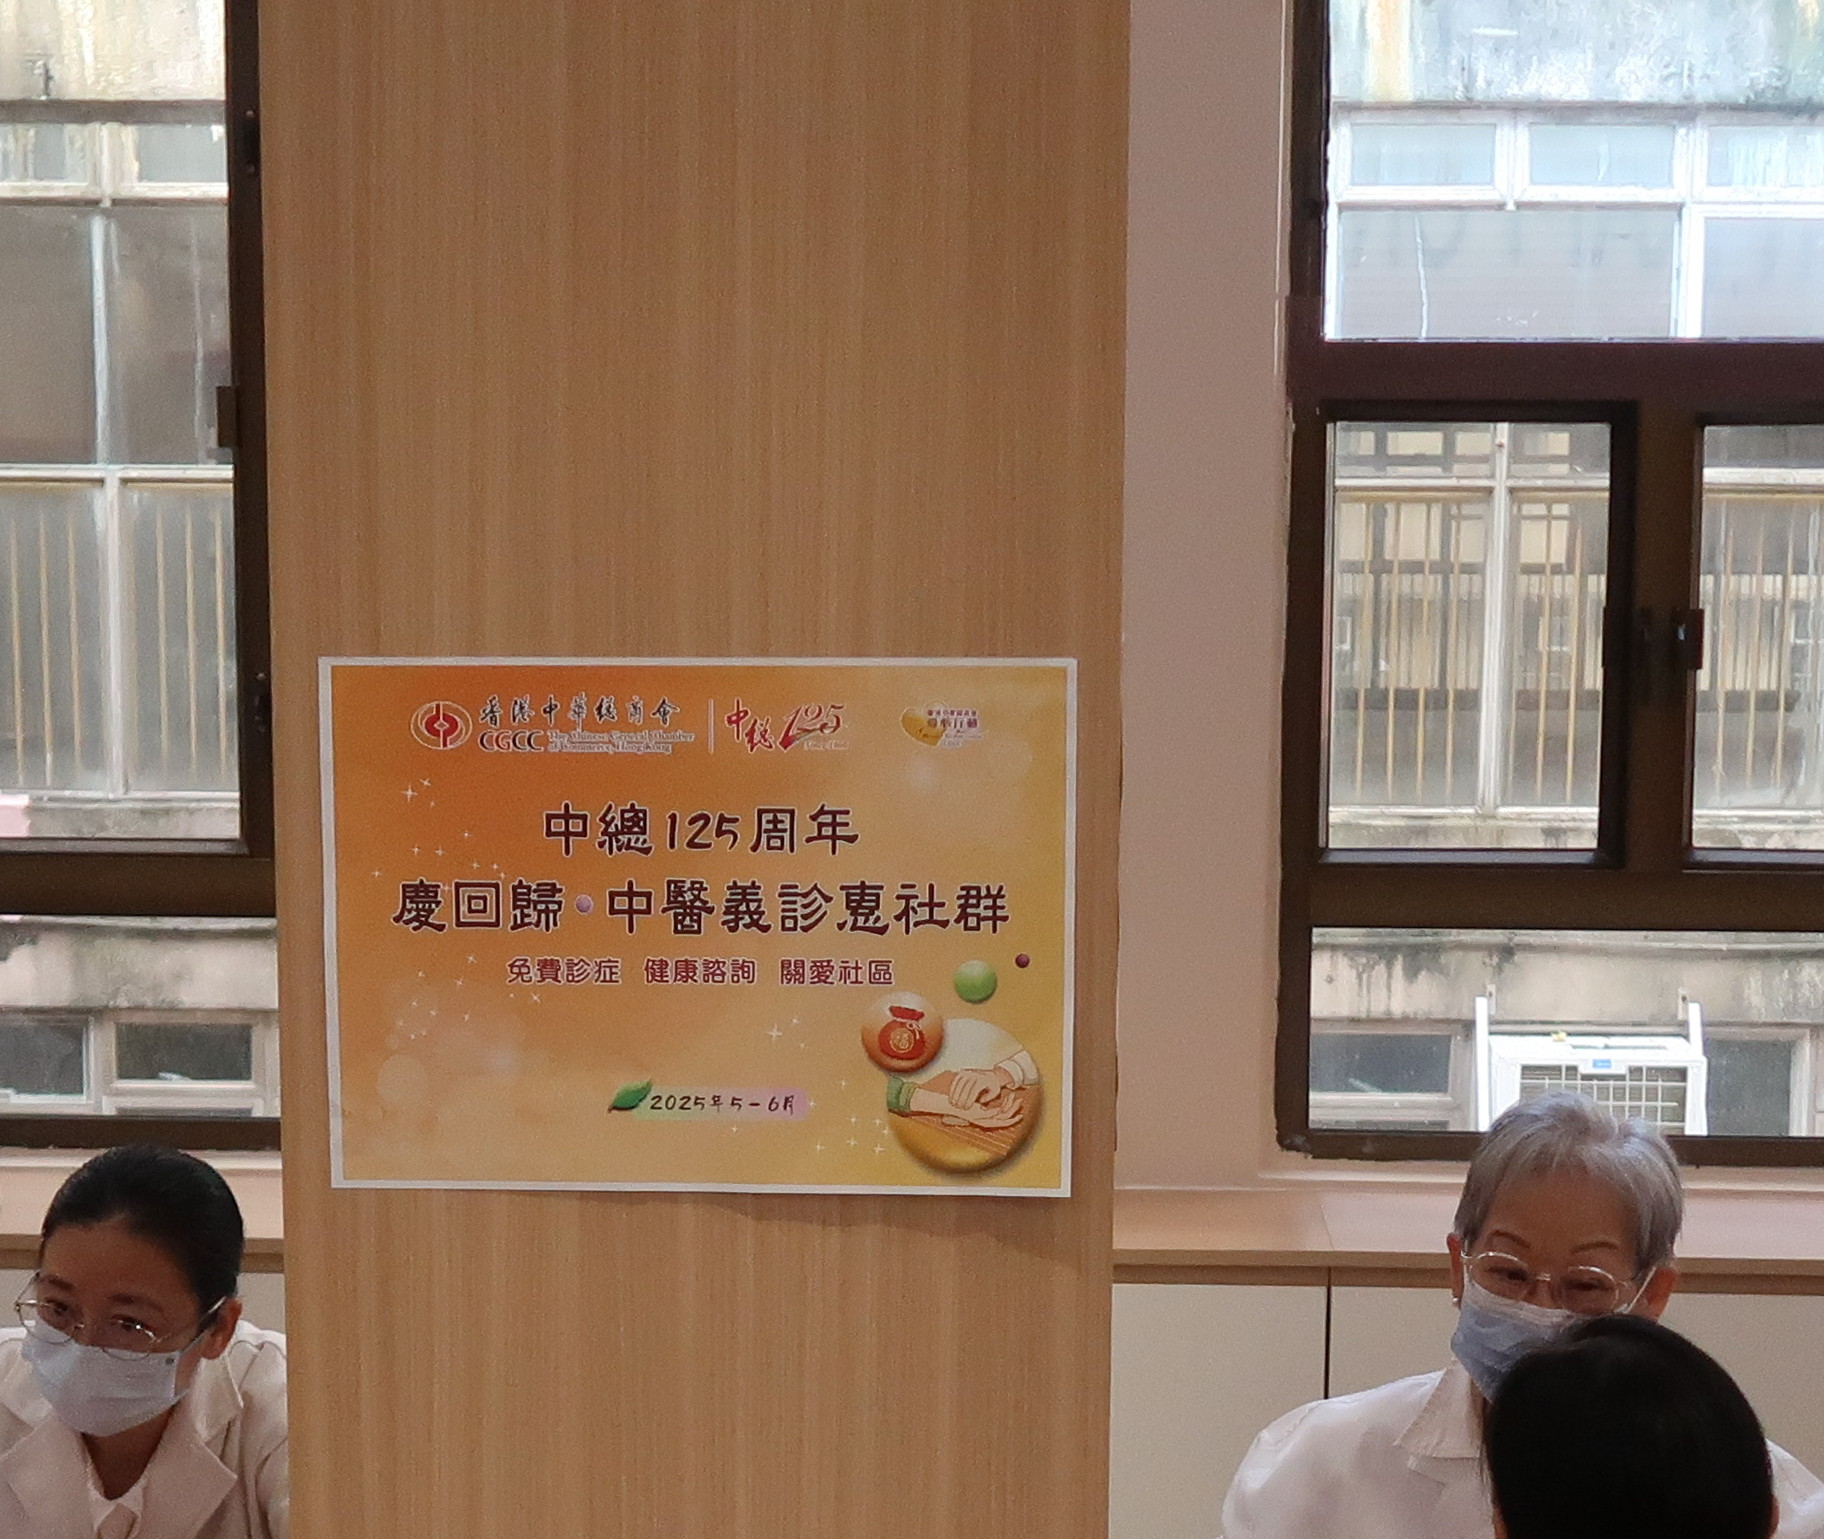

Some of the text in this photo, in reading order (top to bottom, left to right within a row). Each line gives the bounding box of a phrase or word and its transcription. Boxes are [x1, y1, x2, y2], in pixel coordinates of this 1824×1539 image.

[478, 730, 543, 751] CGCC
[544, 801, 860, 857] 中總125周年
[392, 878, 1010, 936] 慶回歸 中醫義診惠社群
[507, 957, 894, 986] 免費診症 健康諮詢 關愛社區
